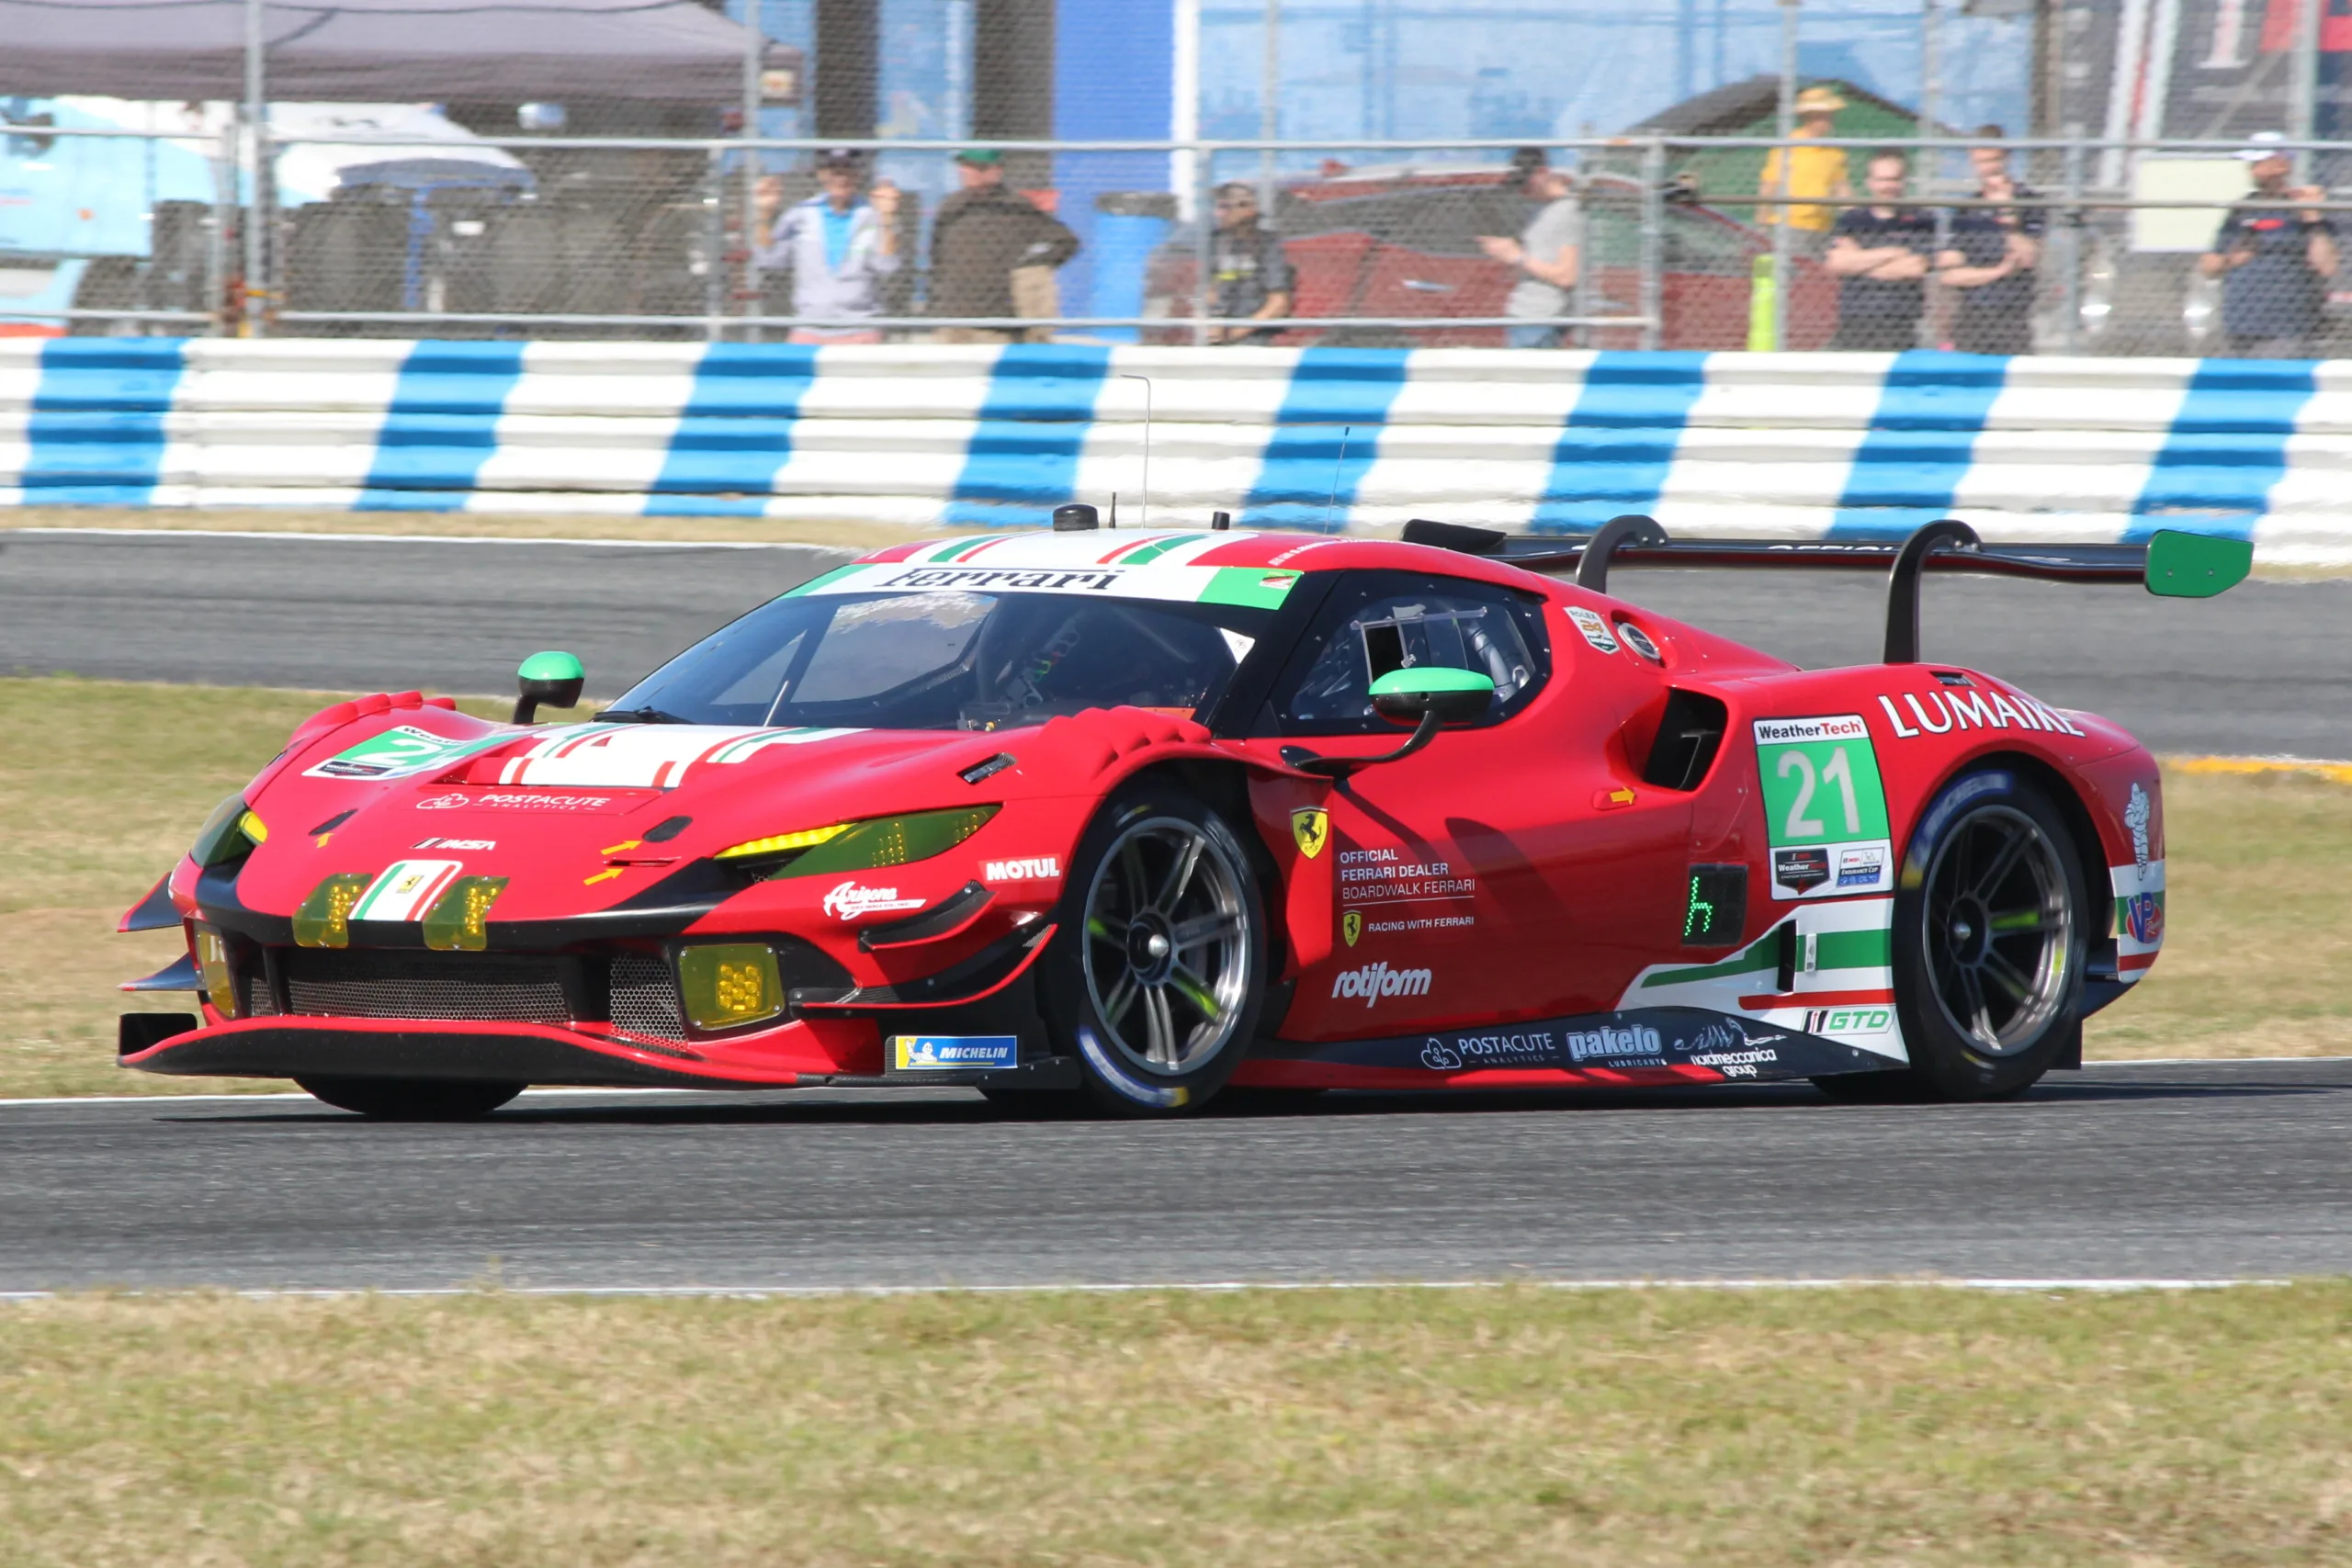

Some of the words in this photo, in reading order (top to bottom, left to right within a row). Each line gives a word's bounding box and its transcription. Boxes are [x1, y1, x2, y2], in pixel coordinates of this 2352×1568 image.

[874, 567, 1126, 591] Ferrari
[1758, 720, 1861, 739] WeatherTech
[479, 794, 611, 807] POSTACUTE
[1777, 746, 1860, 838] 21
[1340, 849, 1398, 863] OFFICIAL
[986, 857, 1060, 881] MOTUL
[1341, 866, 1396, 882] FERRARI
[1399, 863, 1449, 877] DEALER
[1342, 883, 1420, 899] BOARDWALK
[1424, 879, 1476, 894] FERRARI
[1368, 921, 1405, 932] RACING
[1408, 919, 1431, 930] WITH
[1434, 916, 1475, 928] FERRARI
[1332, 962, 1431, 1008] rotiform
[1828, 1010, 1890, 1030] GTD
[1457, 1032, 1555, 1055] POSTACUTE
[1566, 1024, 1662, 1061] pakelo
[939, 1046, 1008, 1059] MICHELIN
[1483, 1055, 1545, 1064] ANALYTICS
[1690, 1047, 1778, 1066] nordmeccanica
[1608, 1057, 1668, 1068] LUBRICANTS
[1722, 1064, 1758, 1077] group
